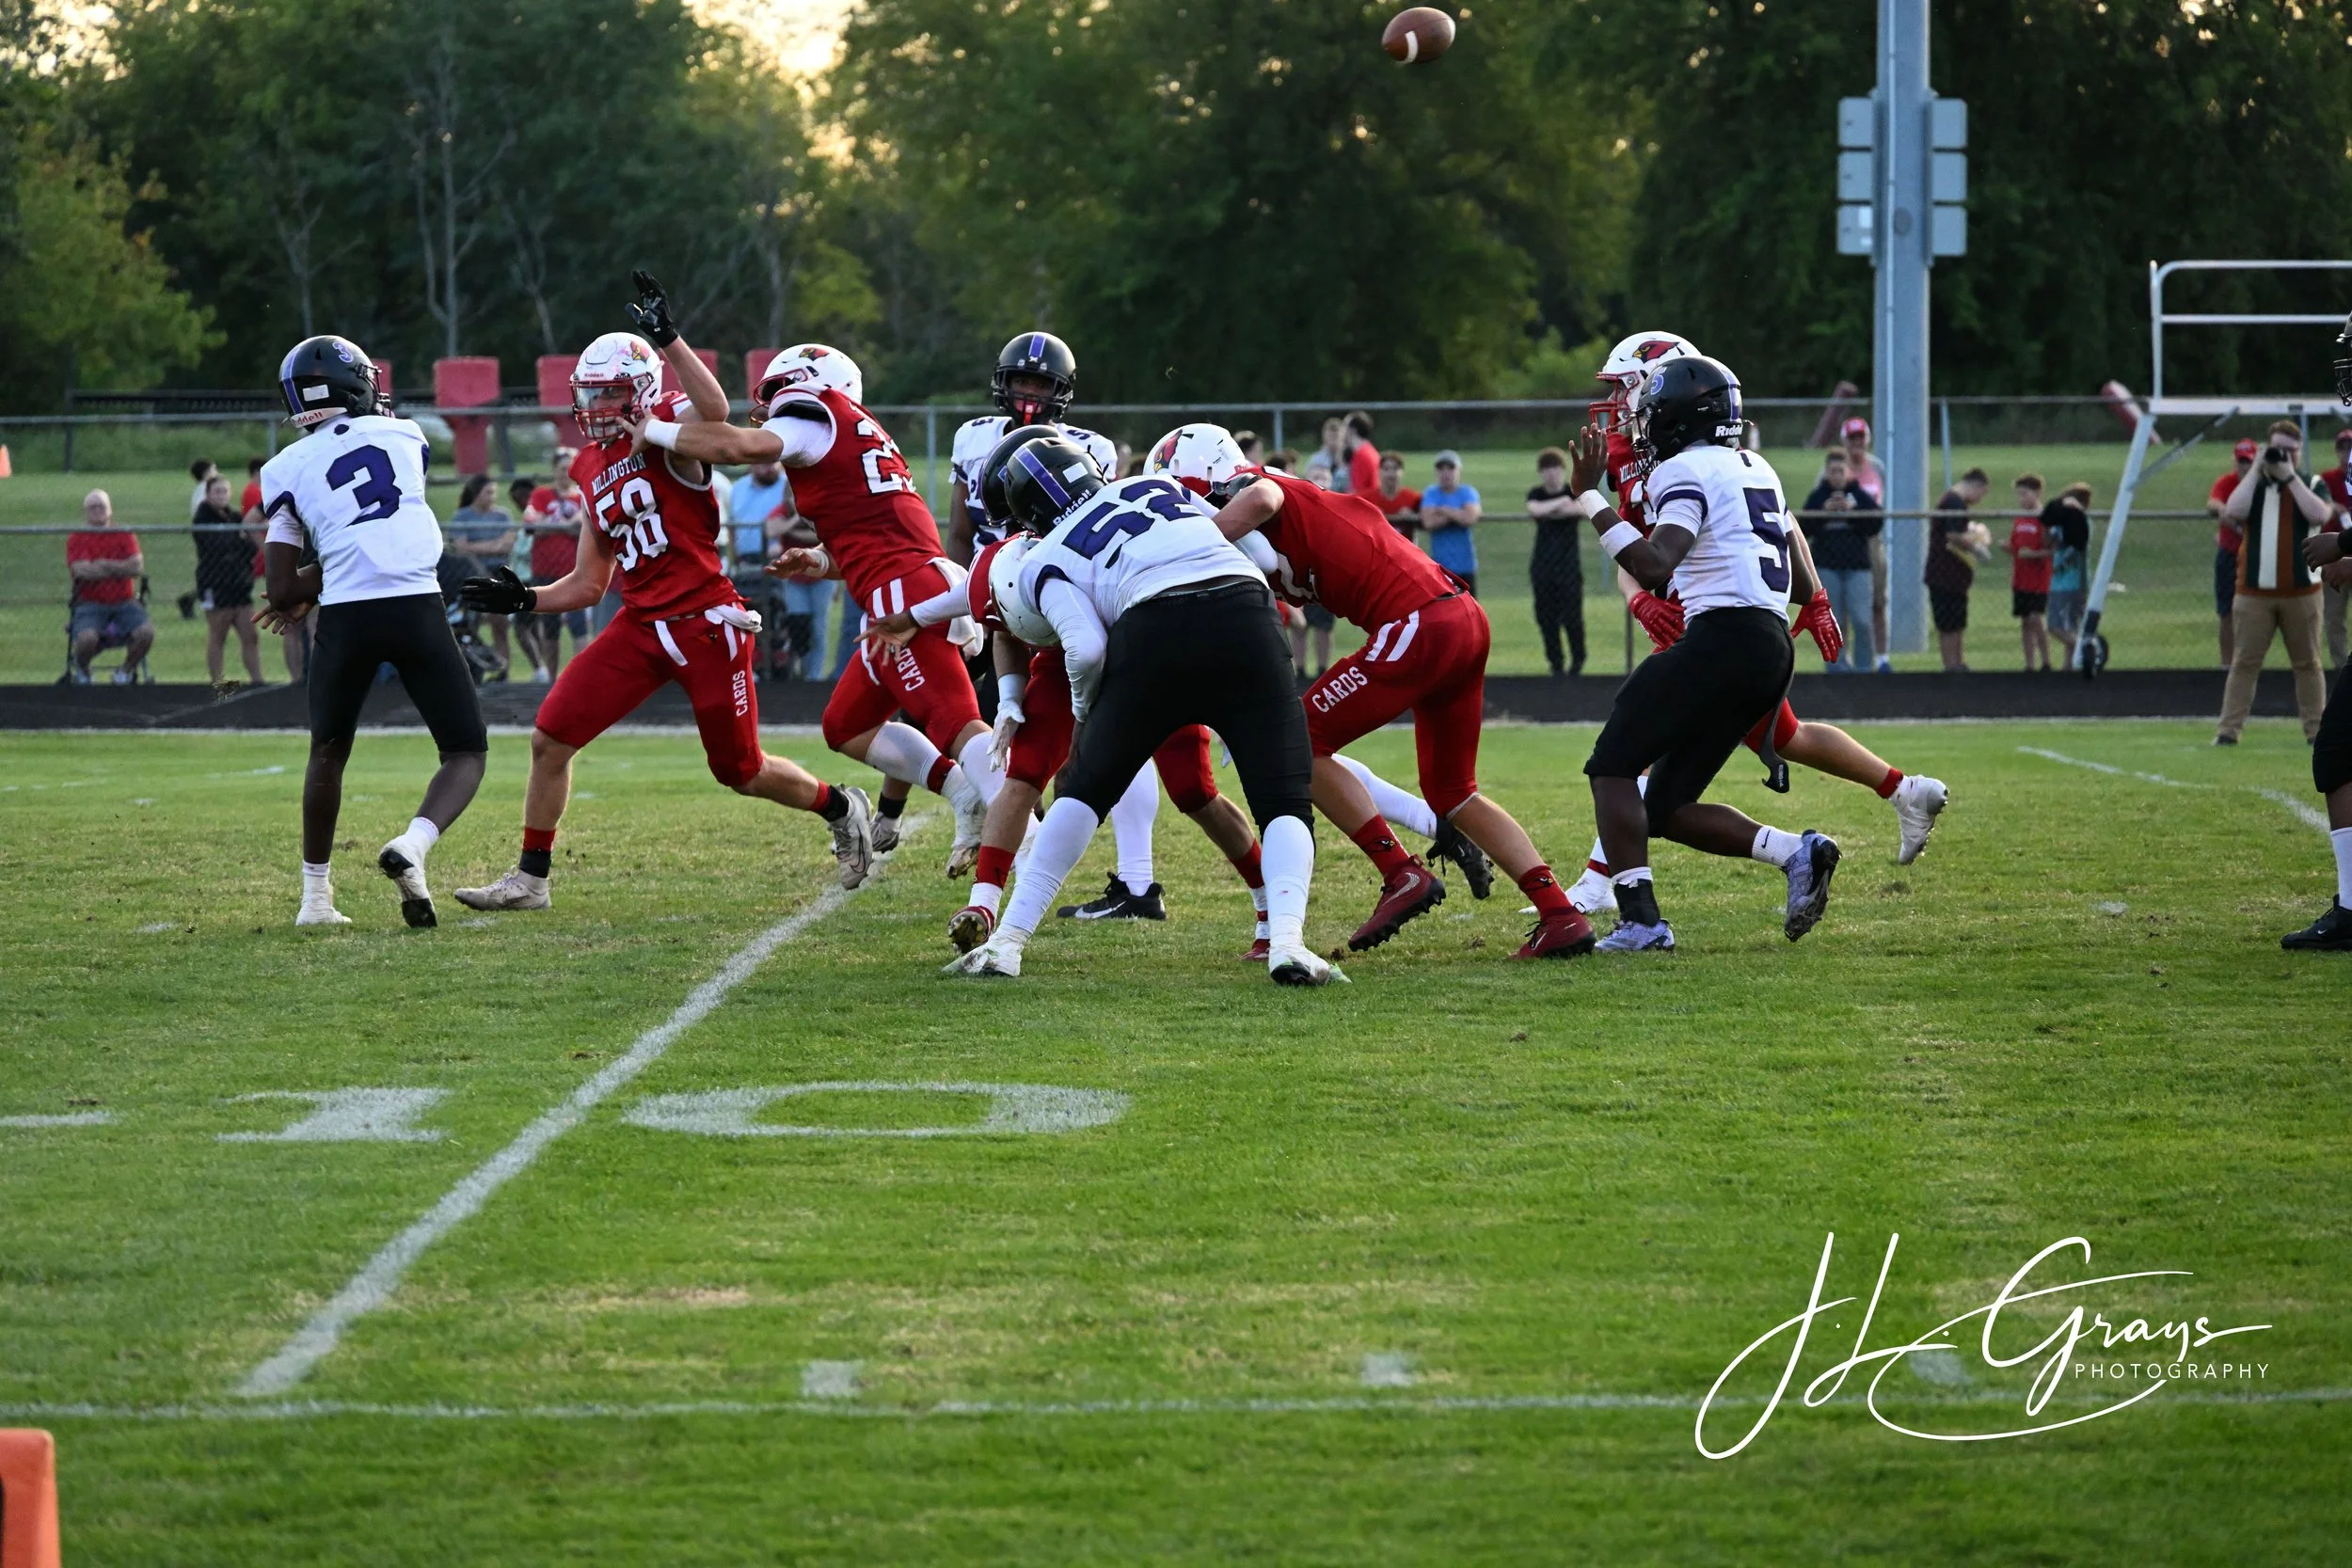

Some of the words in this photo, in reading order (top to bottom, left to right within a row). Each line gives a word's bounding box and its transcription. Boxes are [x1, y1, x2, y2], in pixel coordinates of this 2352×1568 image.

[332, 341, 354, 363] 3
[1649, 366, 1668, 396] 5
[326, 445, 403, 526] 3
[592, 452, 646, 497] MILLINGTON
[595, 477, 669, 572] 58
[1061, 479, 1204, 570] 52
[1741, 486, 1791, 594] 5
[897, 647, 926, 692] CARD
[1311, 665, 1368, 713] CARDS
[732, 670, 749, 718] CARDS
